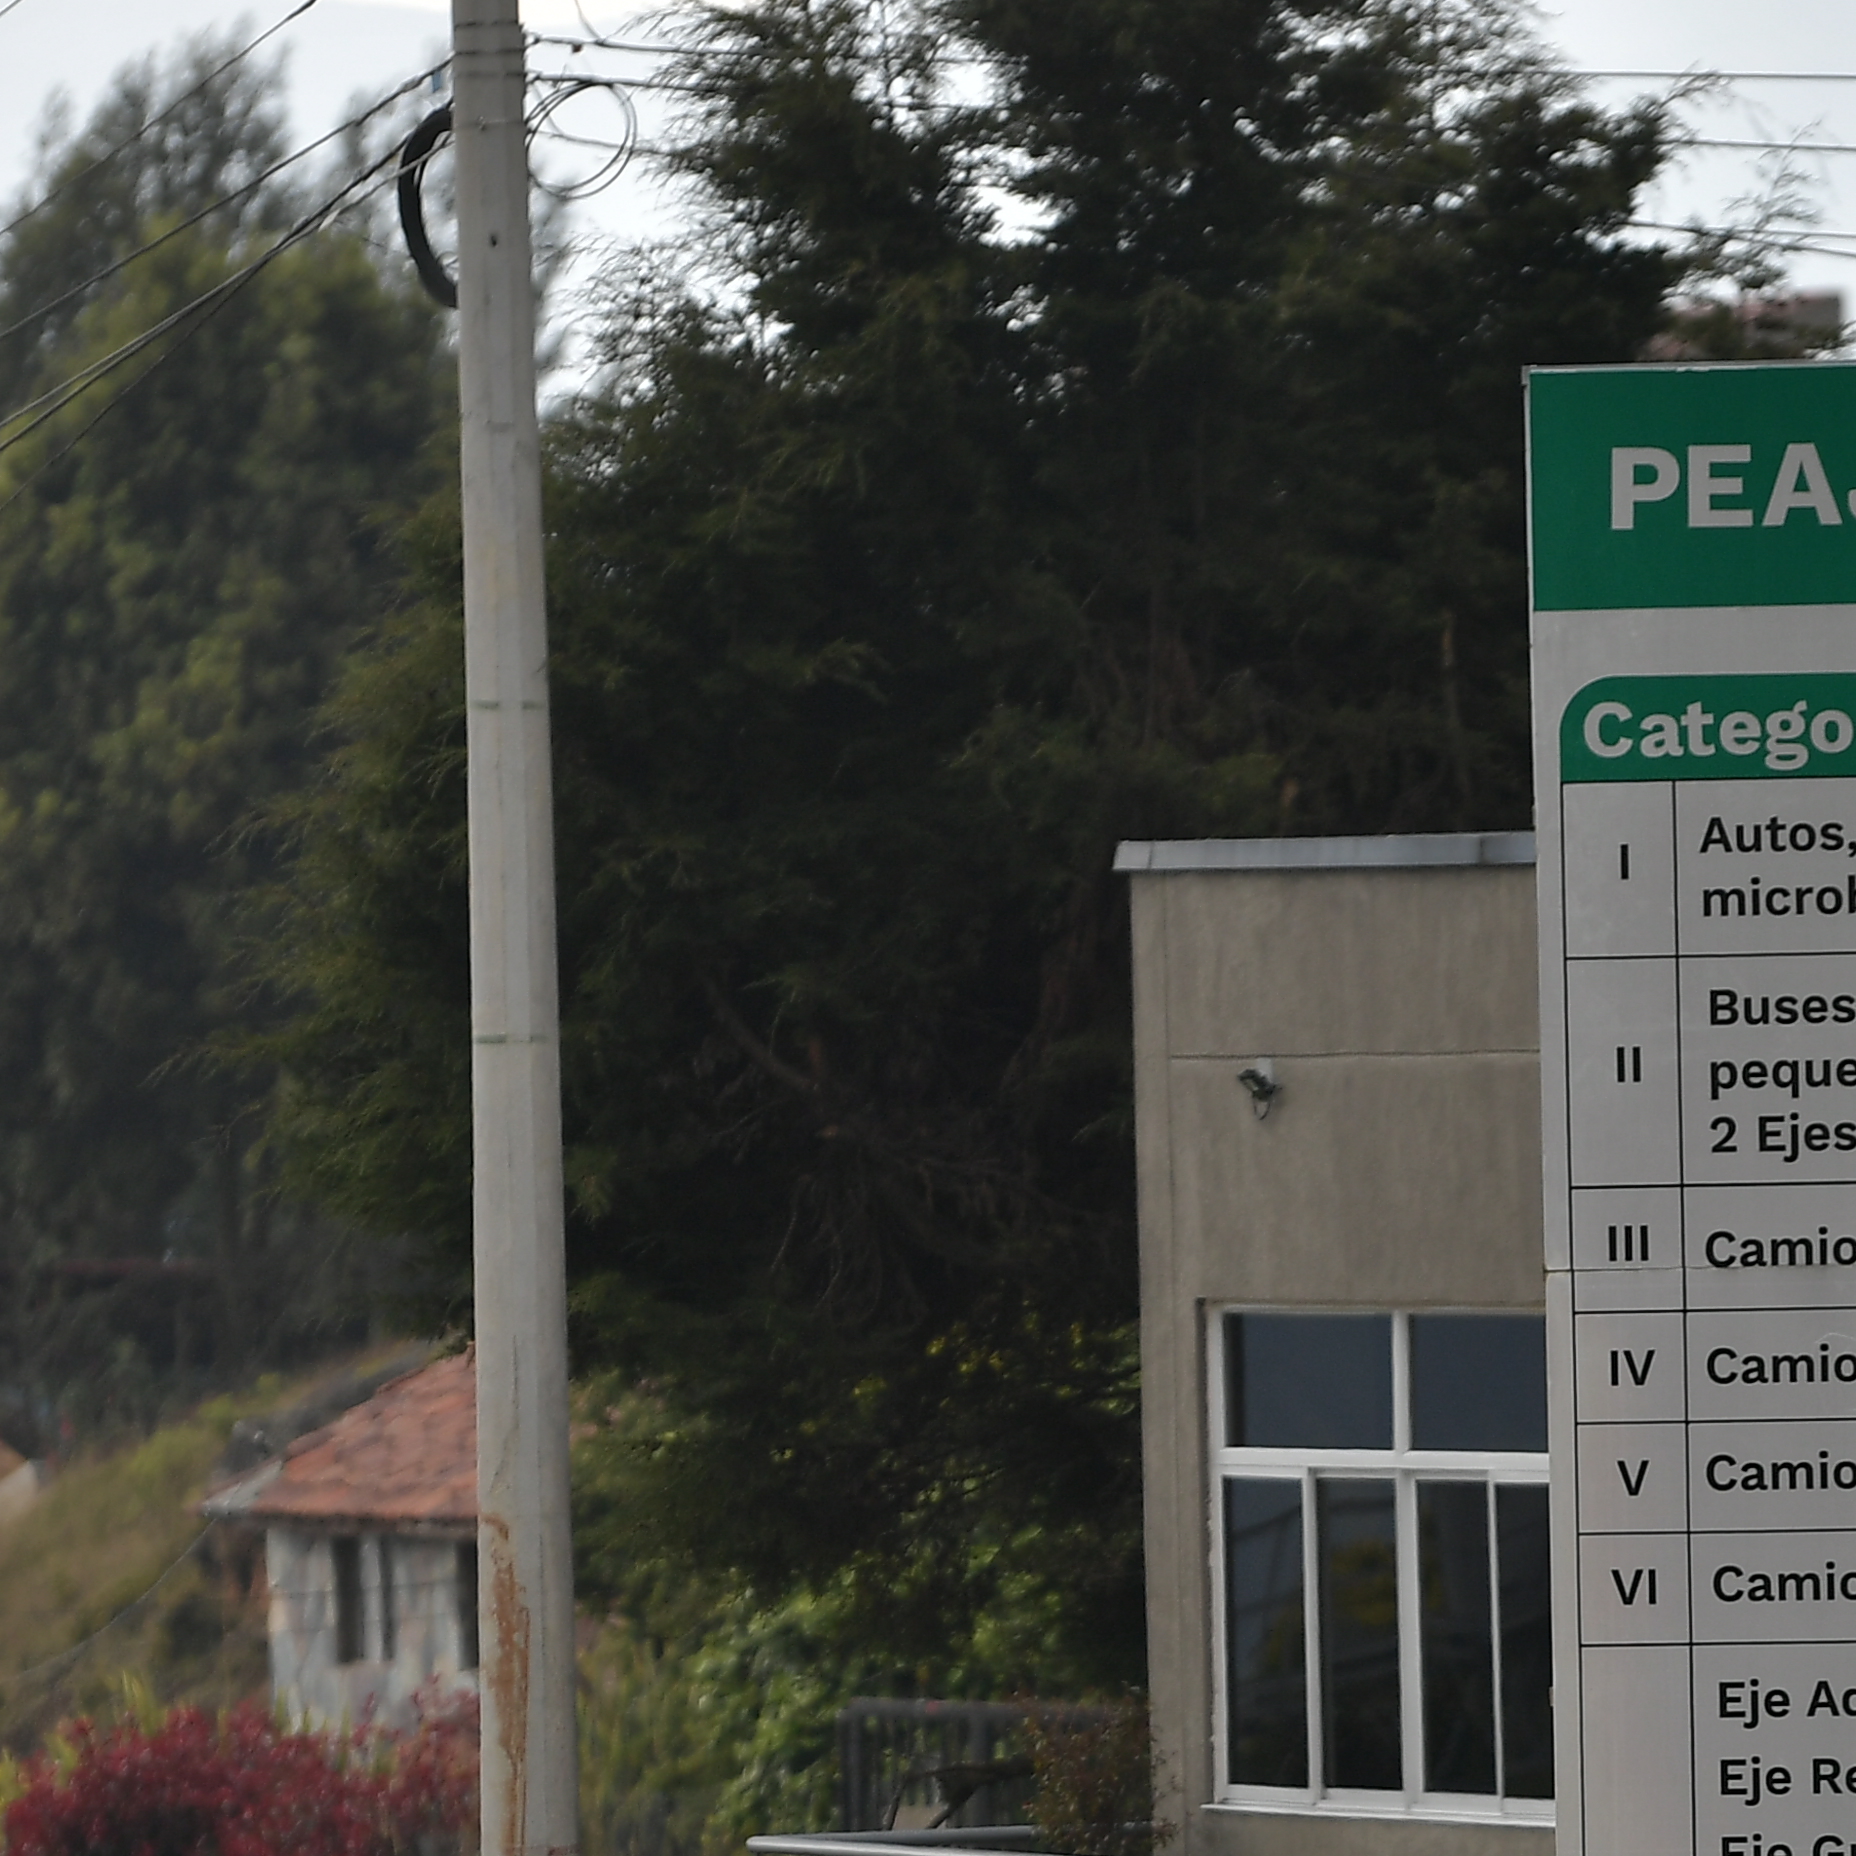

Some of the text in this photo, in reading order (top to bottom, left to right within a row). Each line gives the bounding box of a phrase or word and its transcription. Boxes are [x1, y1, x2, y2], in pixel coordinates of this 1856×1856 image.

[1621, 844, 1629, 879] I
[1617, 1047, 1641, 1082] II
[1711, 1117, 1737, 1153] 2
[1609, 1226, 1648, 1261] III
[1611, 1350, 1655, 1386] IV
[1618, 1460, 1649, 1496] V
[1612, 1569, 1656, 1605] VI
[1719, 1679, 1790, 1729] Eje
[1721, 1757, 1791, 1806] Eje
